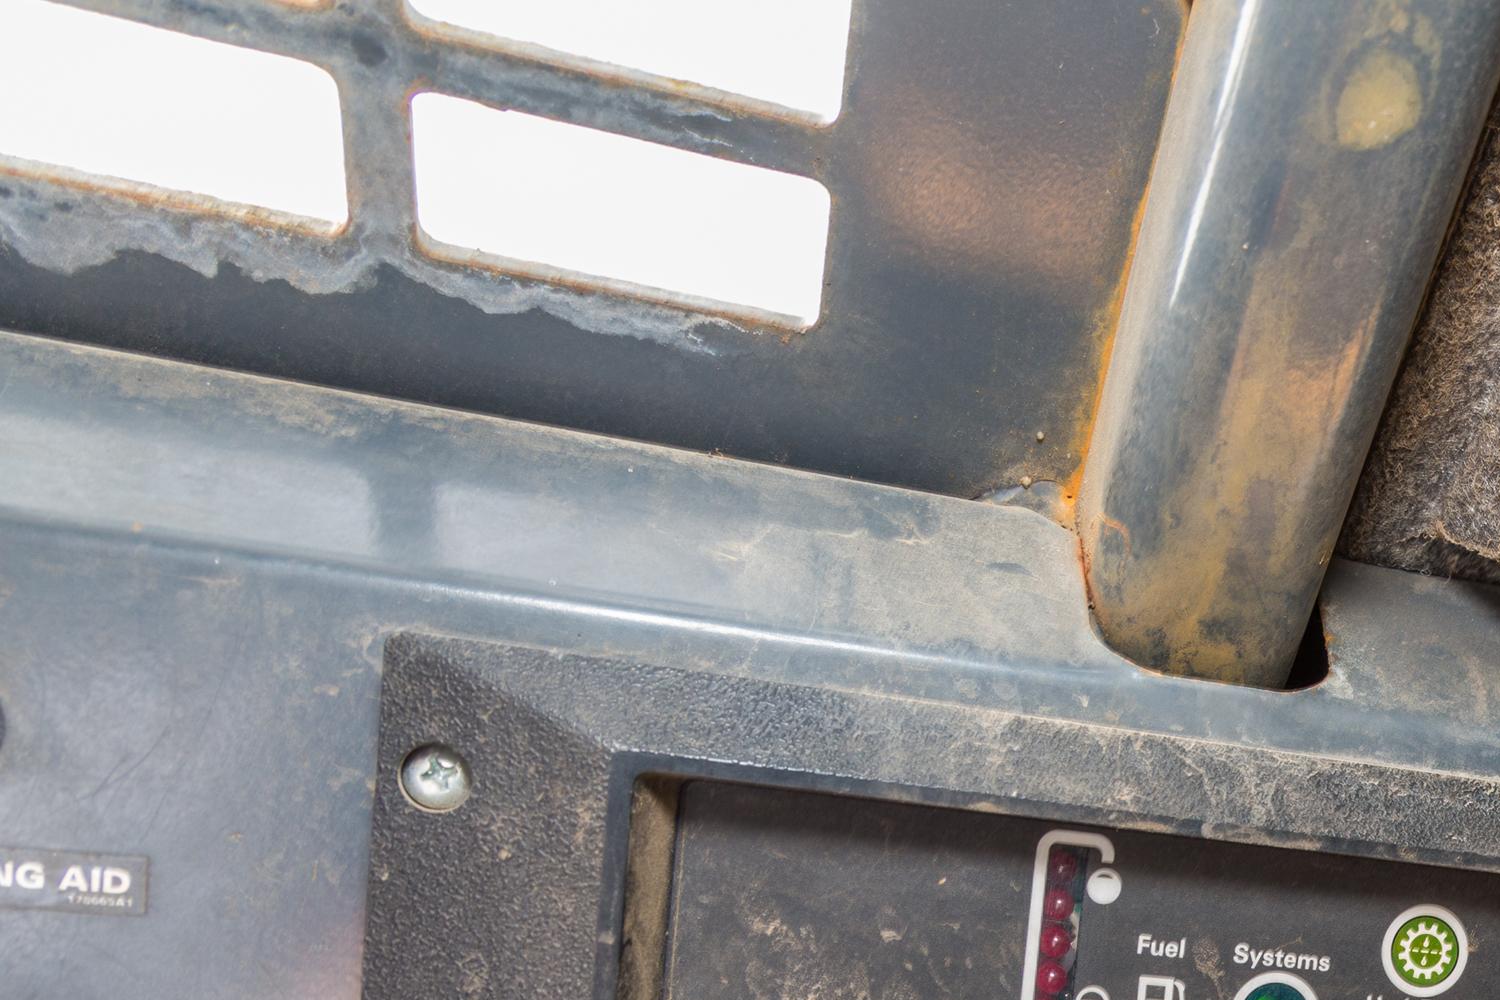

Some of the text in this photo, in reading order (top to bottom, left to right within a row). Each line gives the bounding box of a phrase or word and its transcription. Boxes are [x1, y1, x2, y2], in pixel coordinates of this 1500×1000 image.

[58, 864, 132, 894] AID
[1137, 933, 1187, 958] Fuel
[1233, 942, 1332, 972] Systems
